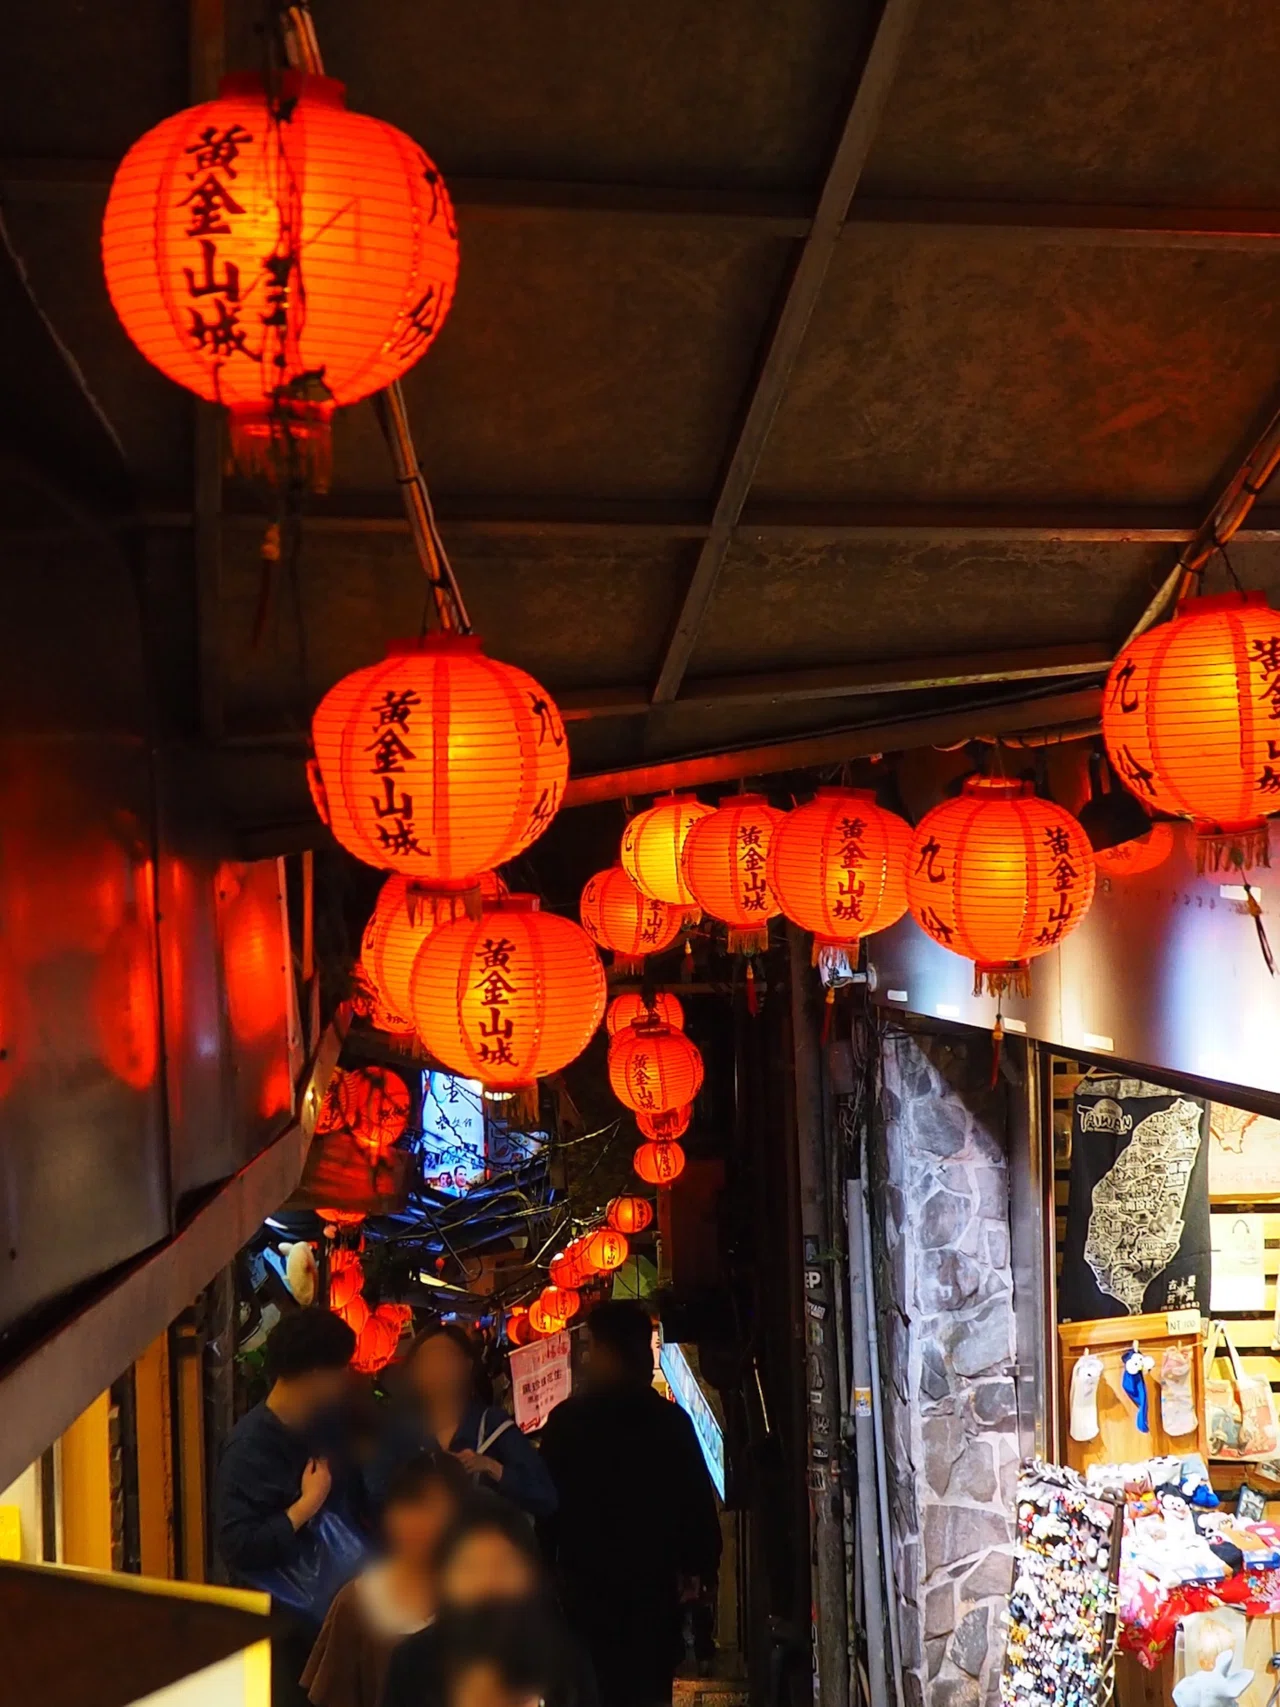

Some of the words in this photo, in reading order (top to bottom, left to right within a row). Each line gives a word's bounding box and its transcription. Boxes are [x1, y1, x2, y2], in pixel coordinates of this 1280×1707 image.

[364, 689, 431, 858] 黃金山城
[738, 826, 769, 912] 黃金山城
[832, 817, 870, 923] 黃金山城
[475, 938, 519, 1067] 黃金山城
